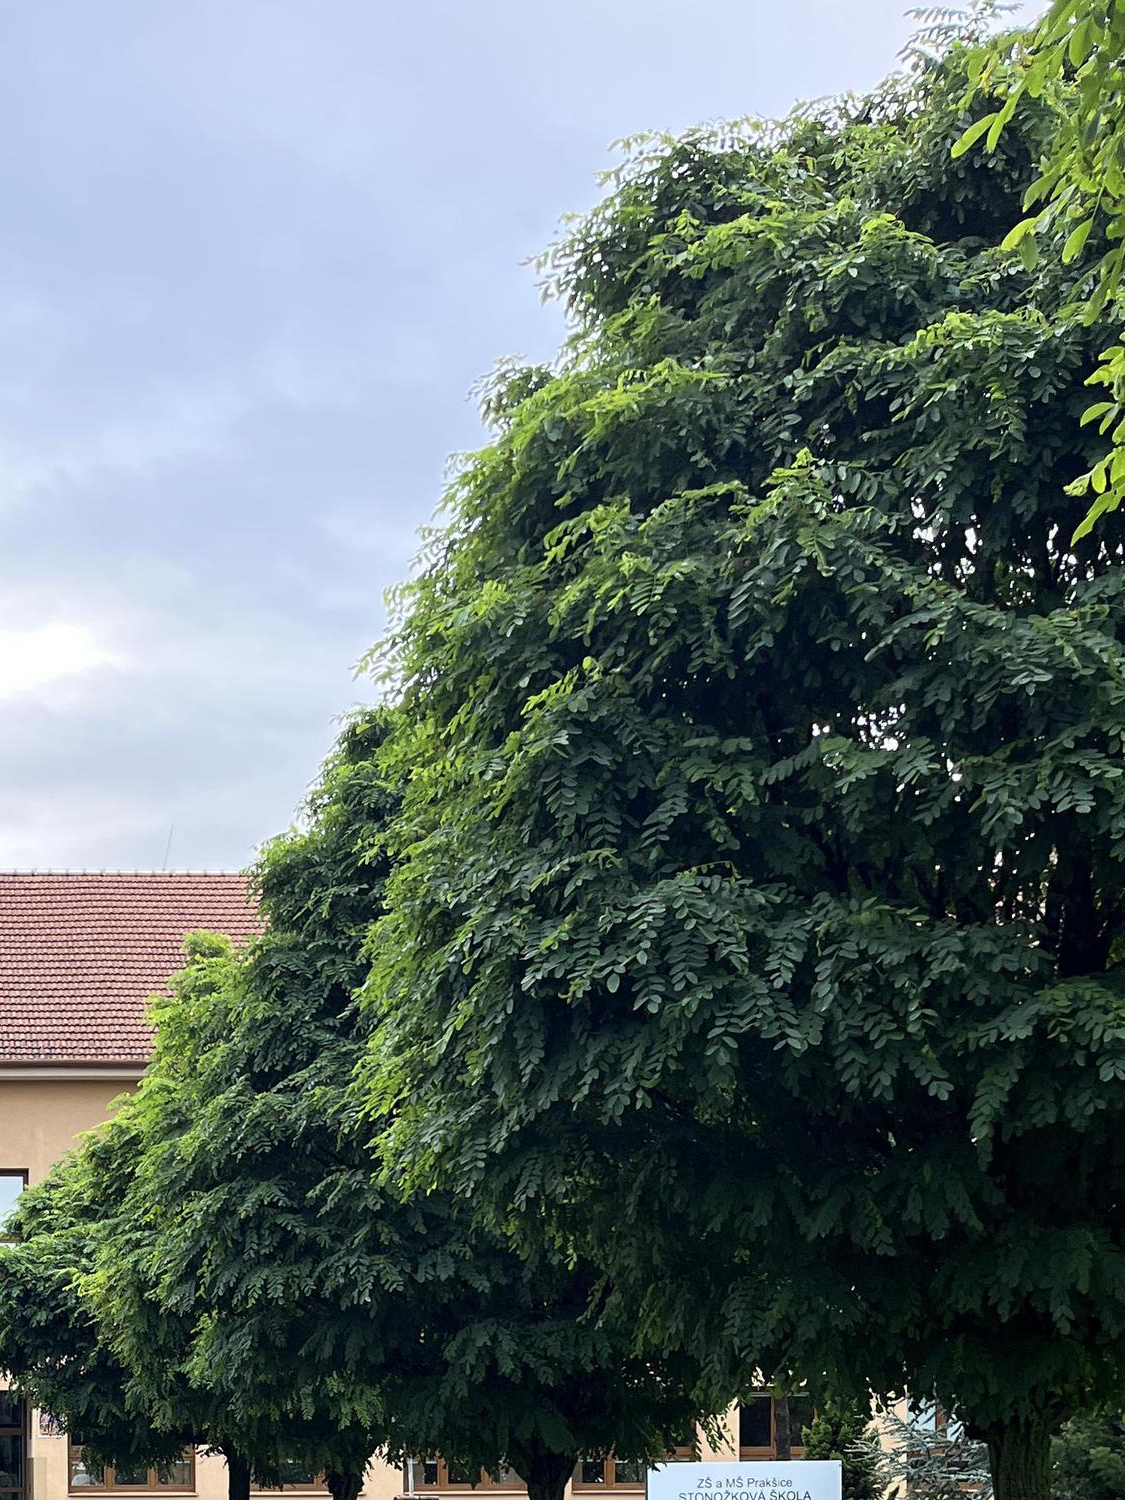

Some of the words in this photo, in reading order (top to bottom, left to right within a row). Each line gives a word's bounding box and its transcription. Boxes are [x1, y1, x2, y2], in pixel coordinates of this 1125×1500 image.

[697, 1477, 713, 1488] ZŠ
[716, 1480, 722, 1488] a
[725, 1476, 744, 1488] MŠ
[747, 1477, 793, 1488] Prakšice
